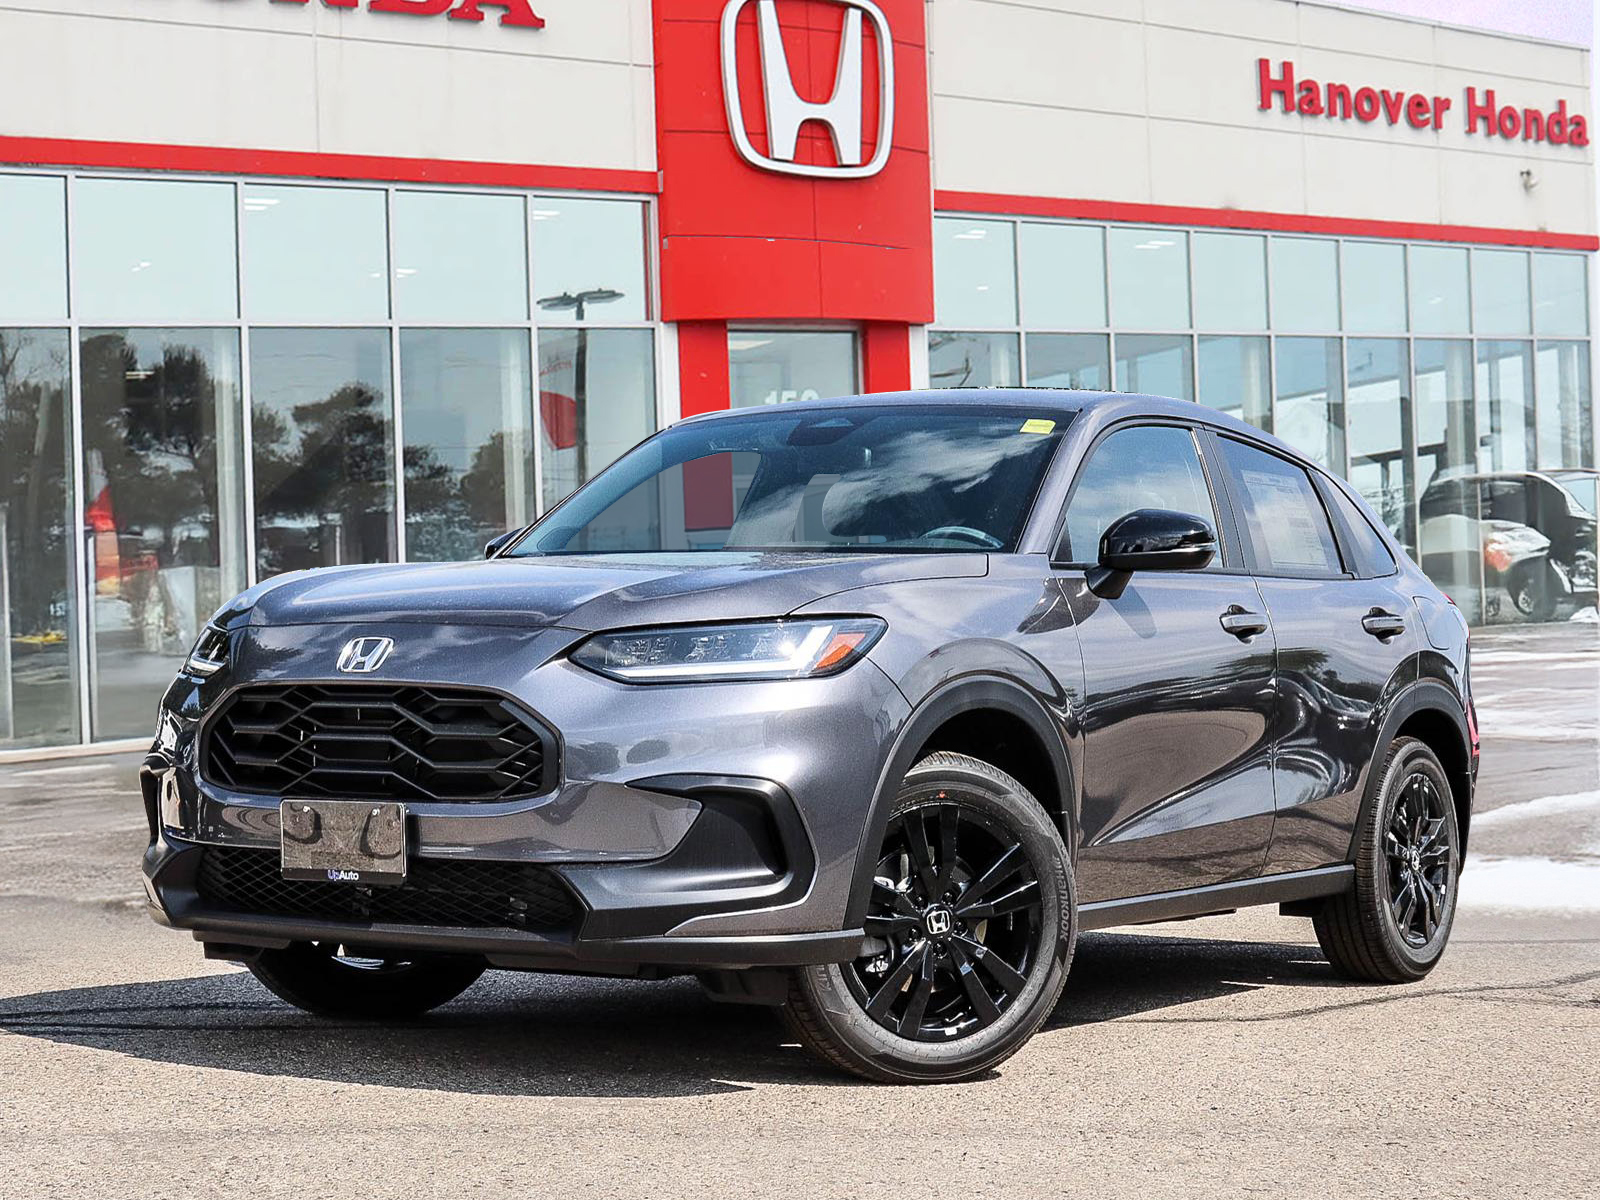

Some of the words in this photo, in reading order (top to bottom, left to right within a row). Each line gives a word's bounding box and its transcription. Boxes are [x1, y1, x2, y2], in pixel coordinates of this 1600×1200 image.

[1256, 57, 1452, 130] Hanover
[1465, 86, 1590, 147] Honda
[328, 870, 359, 881] UpAuto
